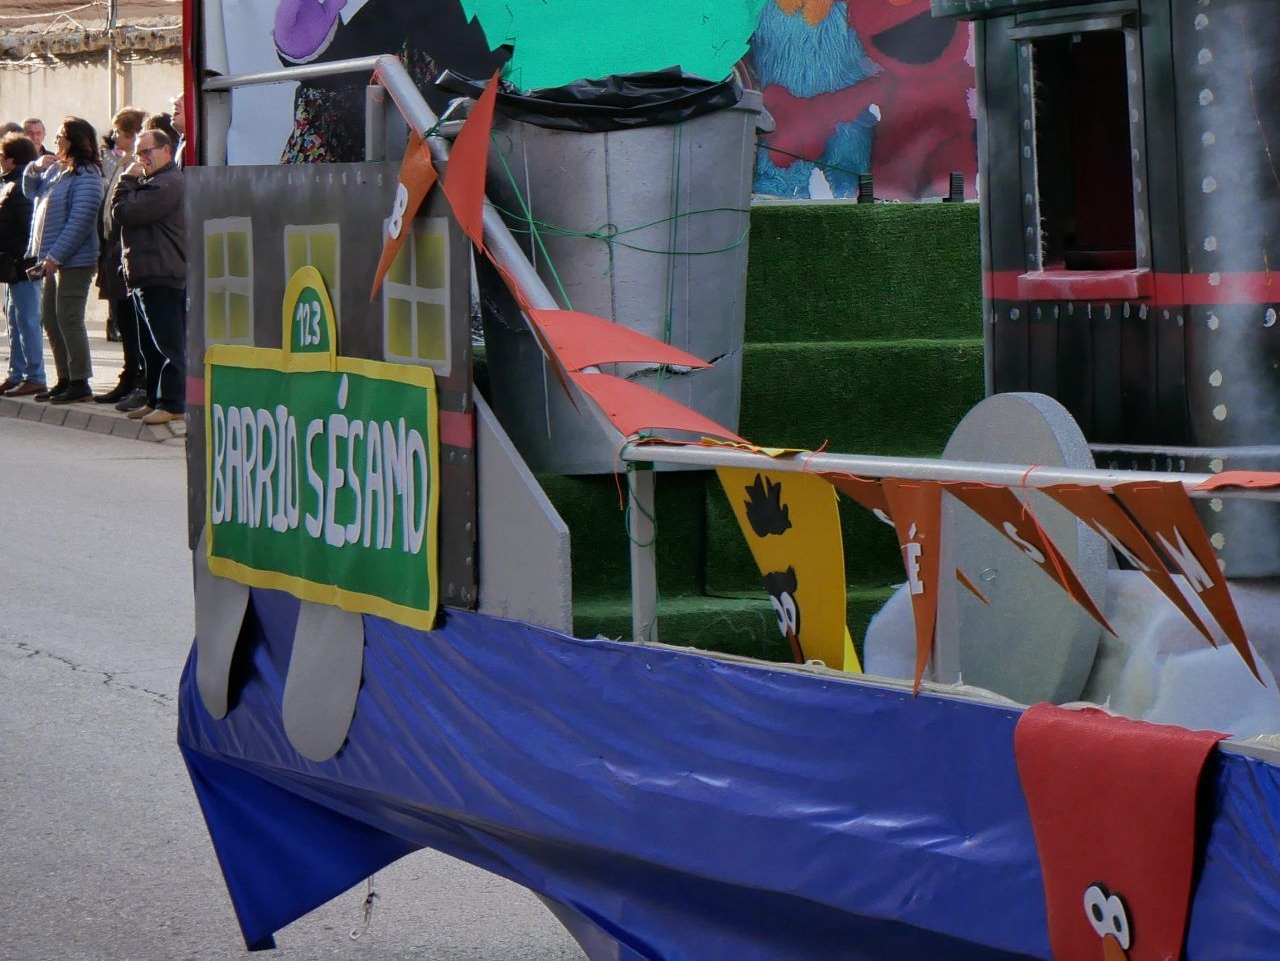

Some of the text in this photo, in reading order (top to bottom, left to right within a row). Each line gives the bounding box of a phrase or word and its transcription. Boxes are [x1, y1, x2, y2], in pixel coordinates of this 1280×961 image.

[389, 182, 409, 240] B
[296, 301, 321, 347] 123
[211, 373, 429, 555] BARRIO SÉSAMO
